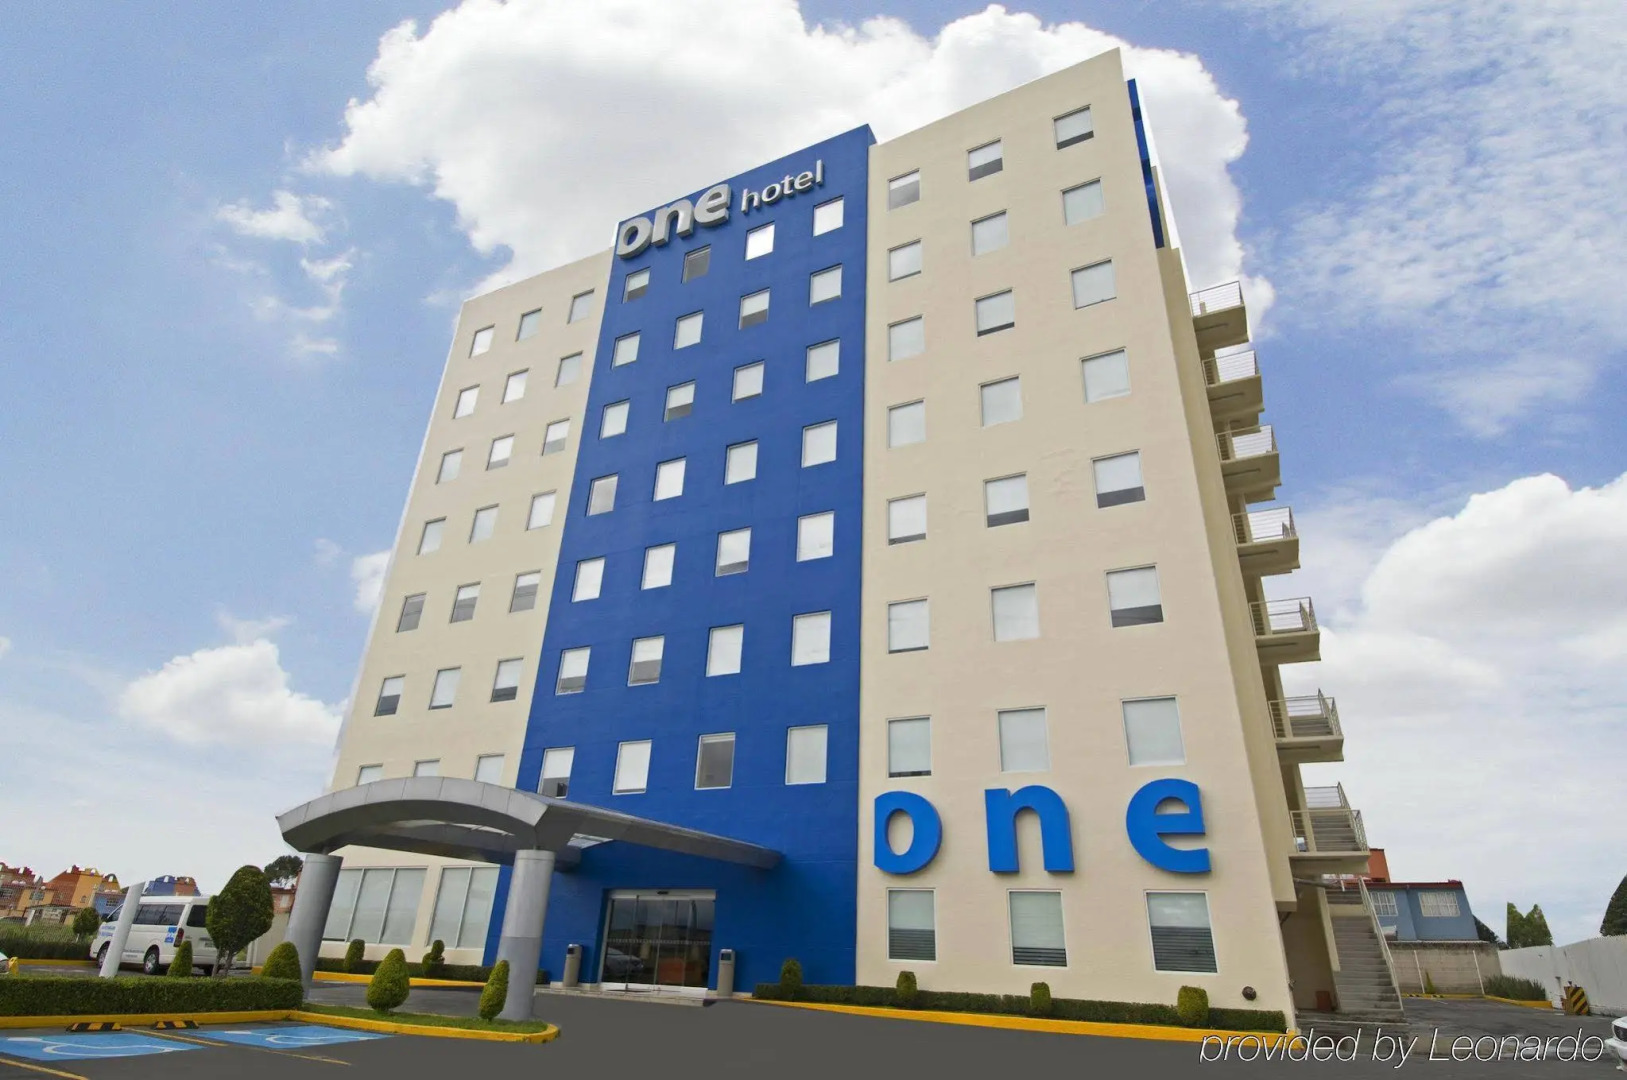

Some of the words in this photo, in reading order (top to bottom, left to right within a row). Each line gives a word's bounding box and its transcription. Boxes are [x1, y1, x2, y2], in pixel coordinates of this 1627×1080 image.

[616, 184, 731, 259] one
[741, 159, 824, 214] hotel
[874, 778, 1211, 874] one
